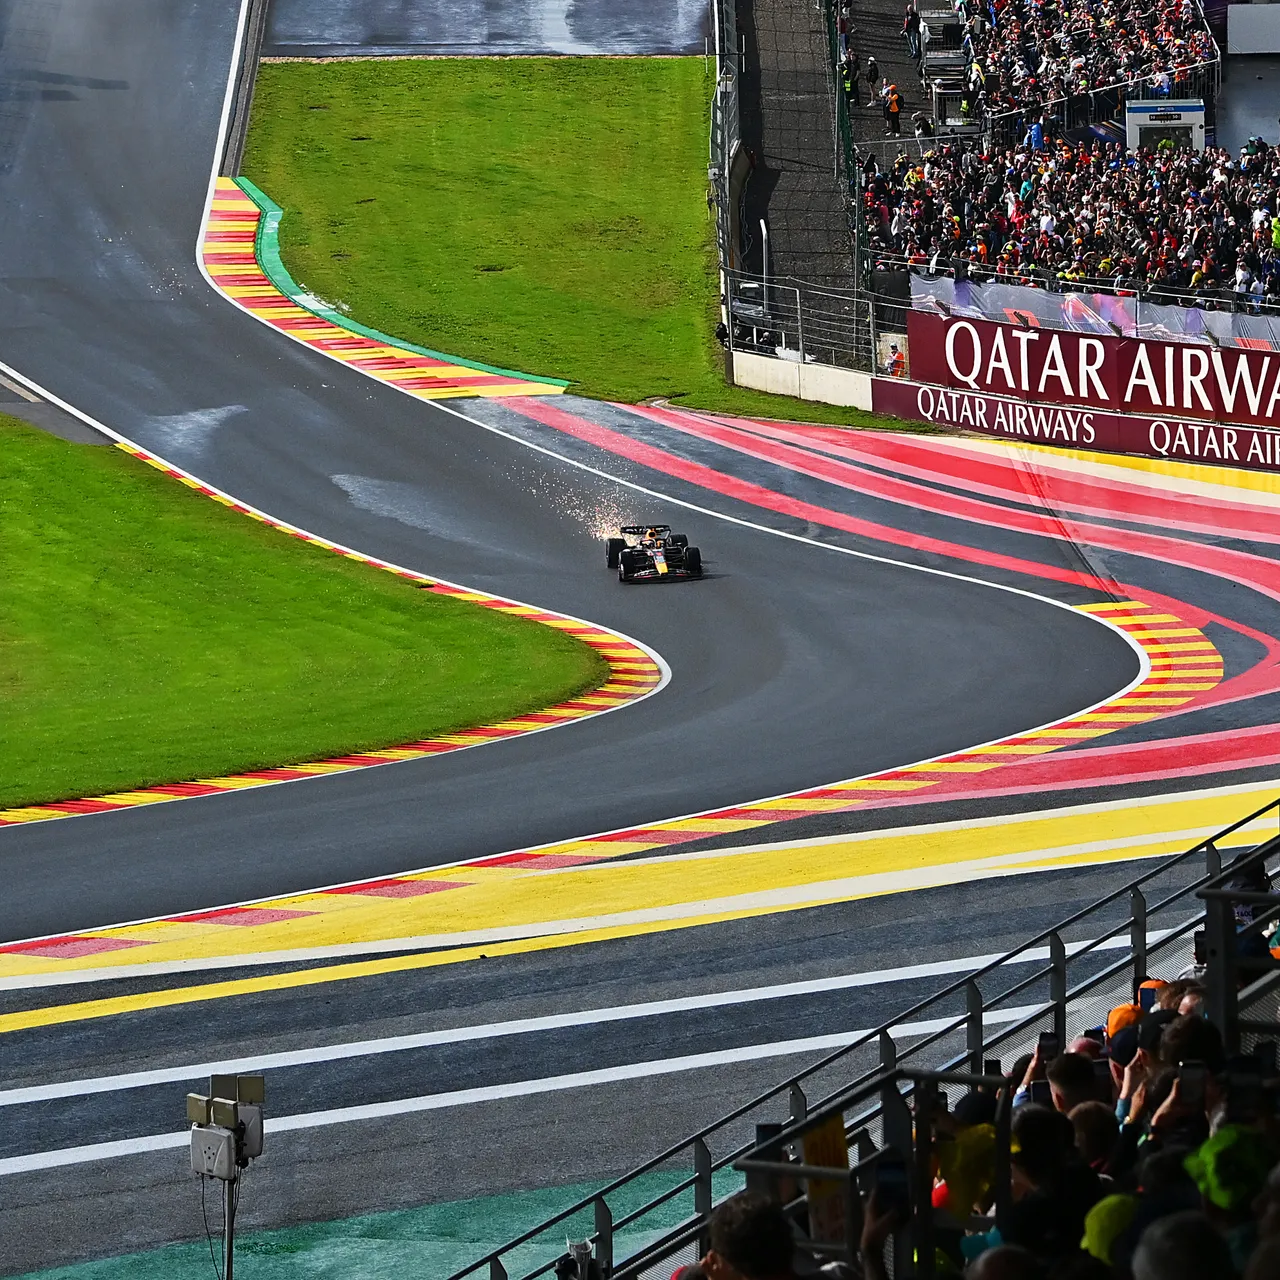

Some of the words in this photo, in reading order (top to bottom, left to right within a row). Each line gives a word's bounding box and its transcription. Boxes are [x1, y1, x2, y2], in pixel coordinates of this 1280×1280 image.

[944, 321, 1110, 401] QATAR
[917, 386, 988, 428] QATAR
[994, 400, 1096, 444] AIRWAYS
[1148, 420, 1239, 461] QATAR
